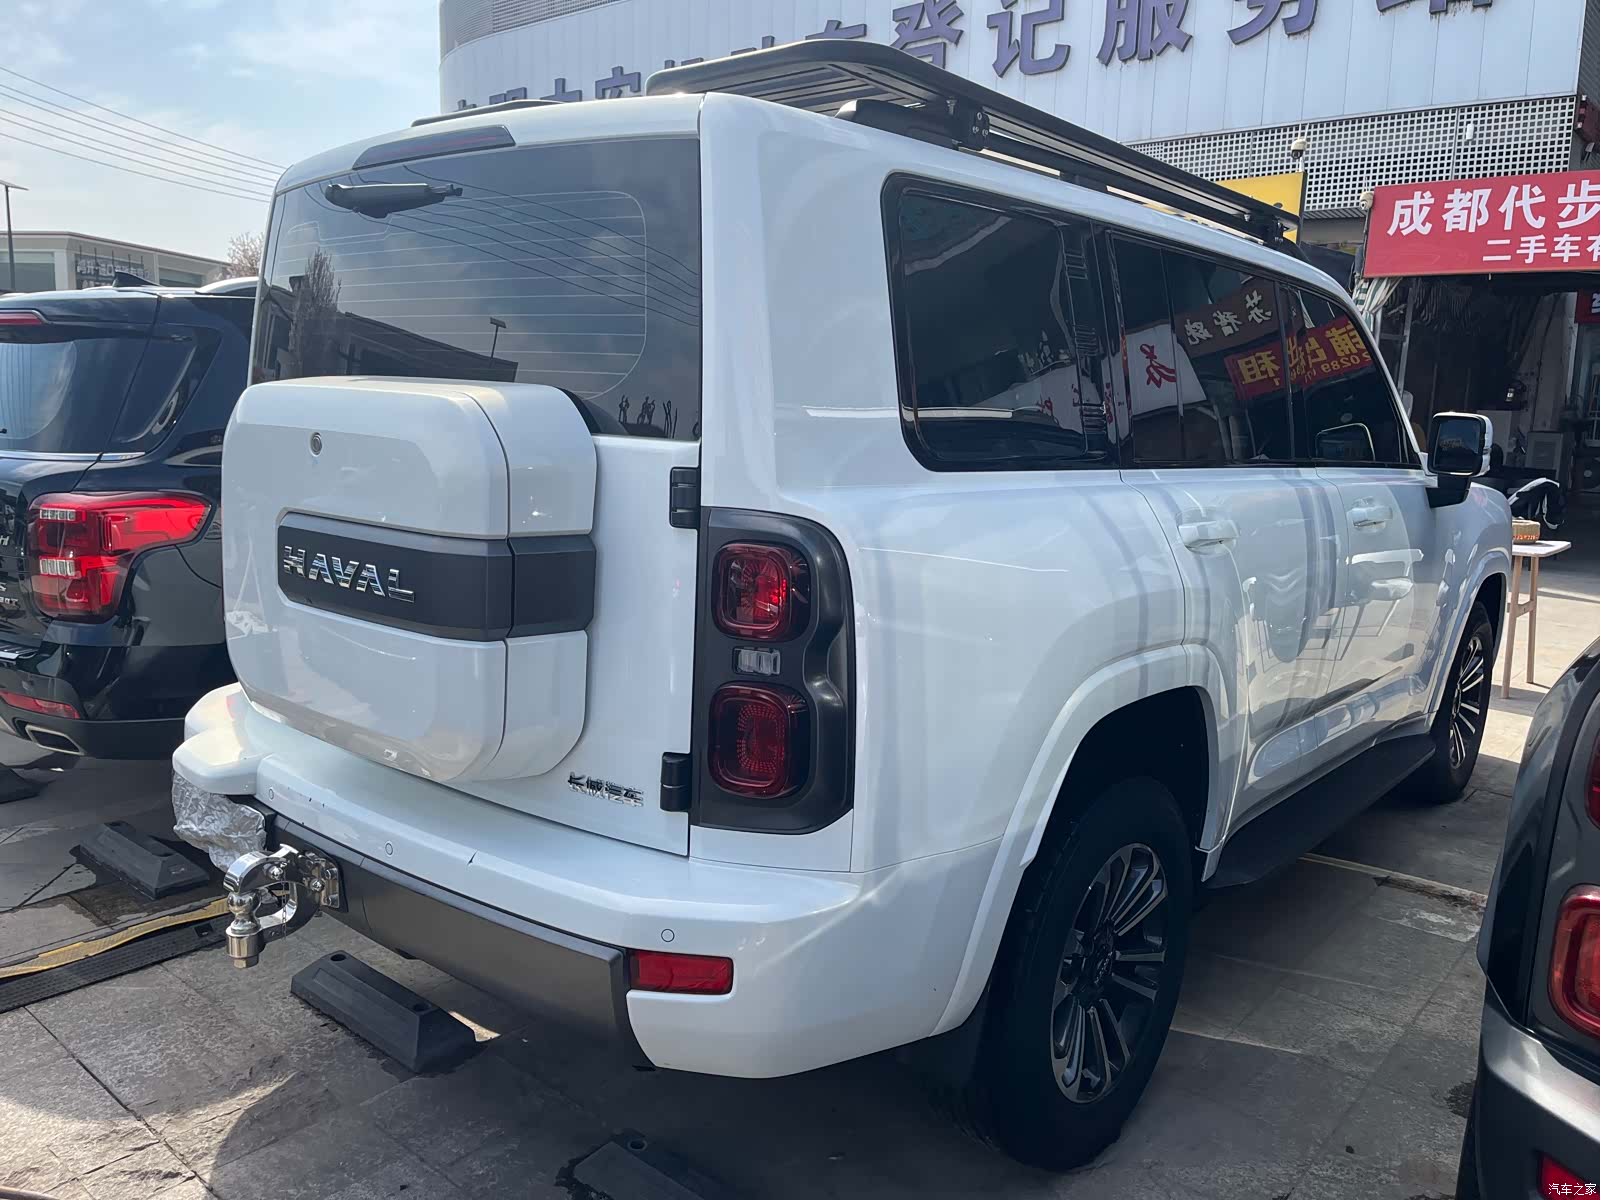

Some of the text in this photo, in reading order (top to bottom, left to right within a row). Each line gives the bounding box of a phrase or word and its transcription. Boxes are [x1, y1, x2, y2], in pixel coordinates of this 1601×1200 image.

[1387, 179, 1601, 236] 成都代步
[283, 545, 415, 603] HAVAL
